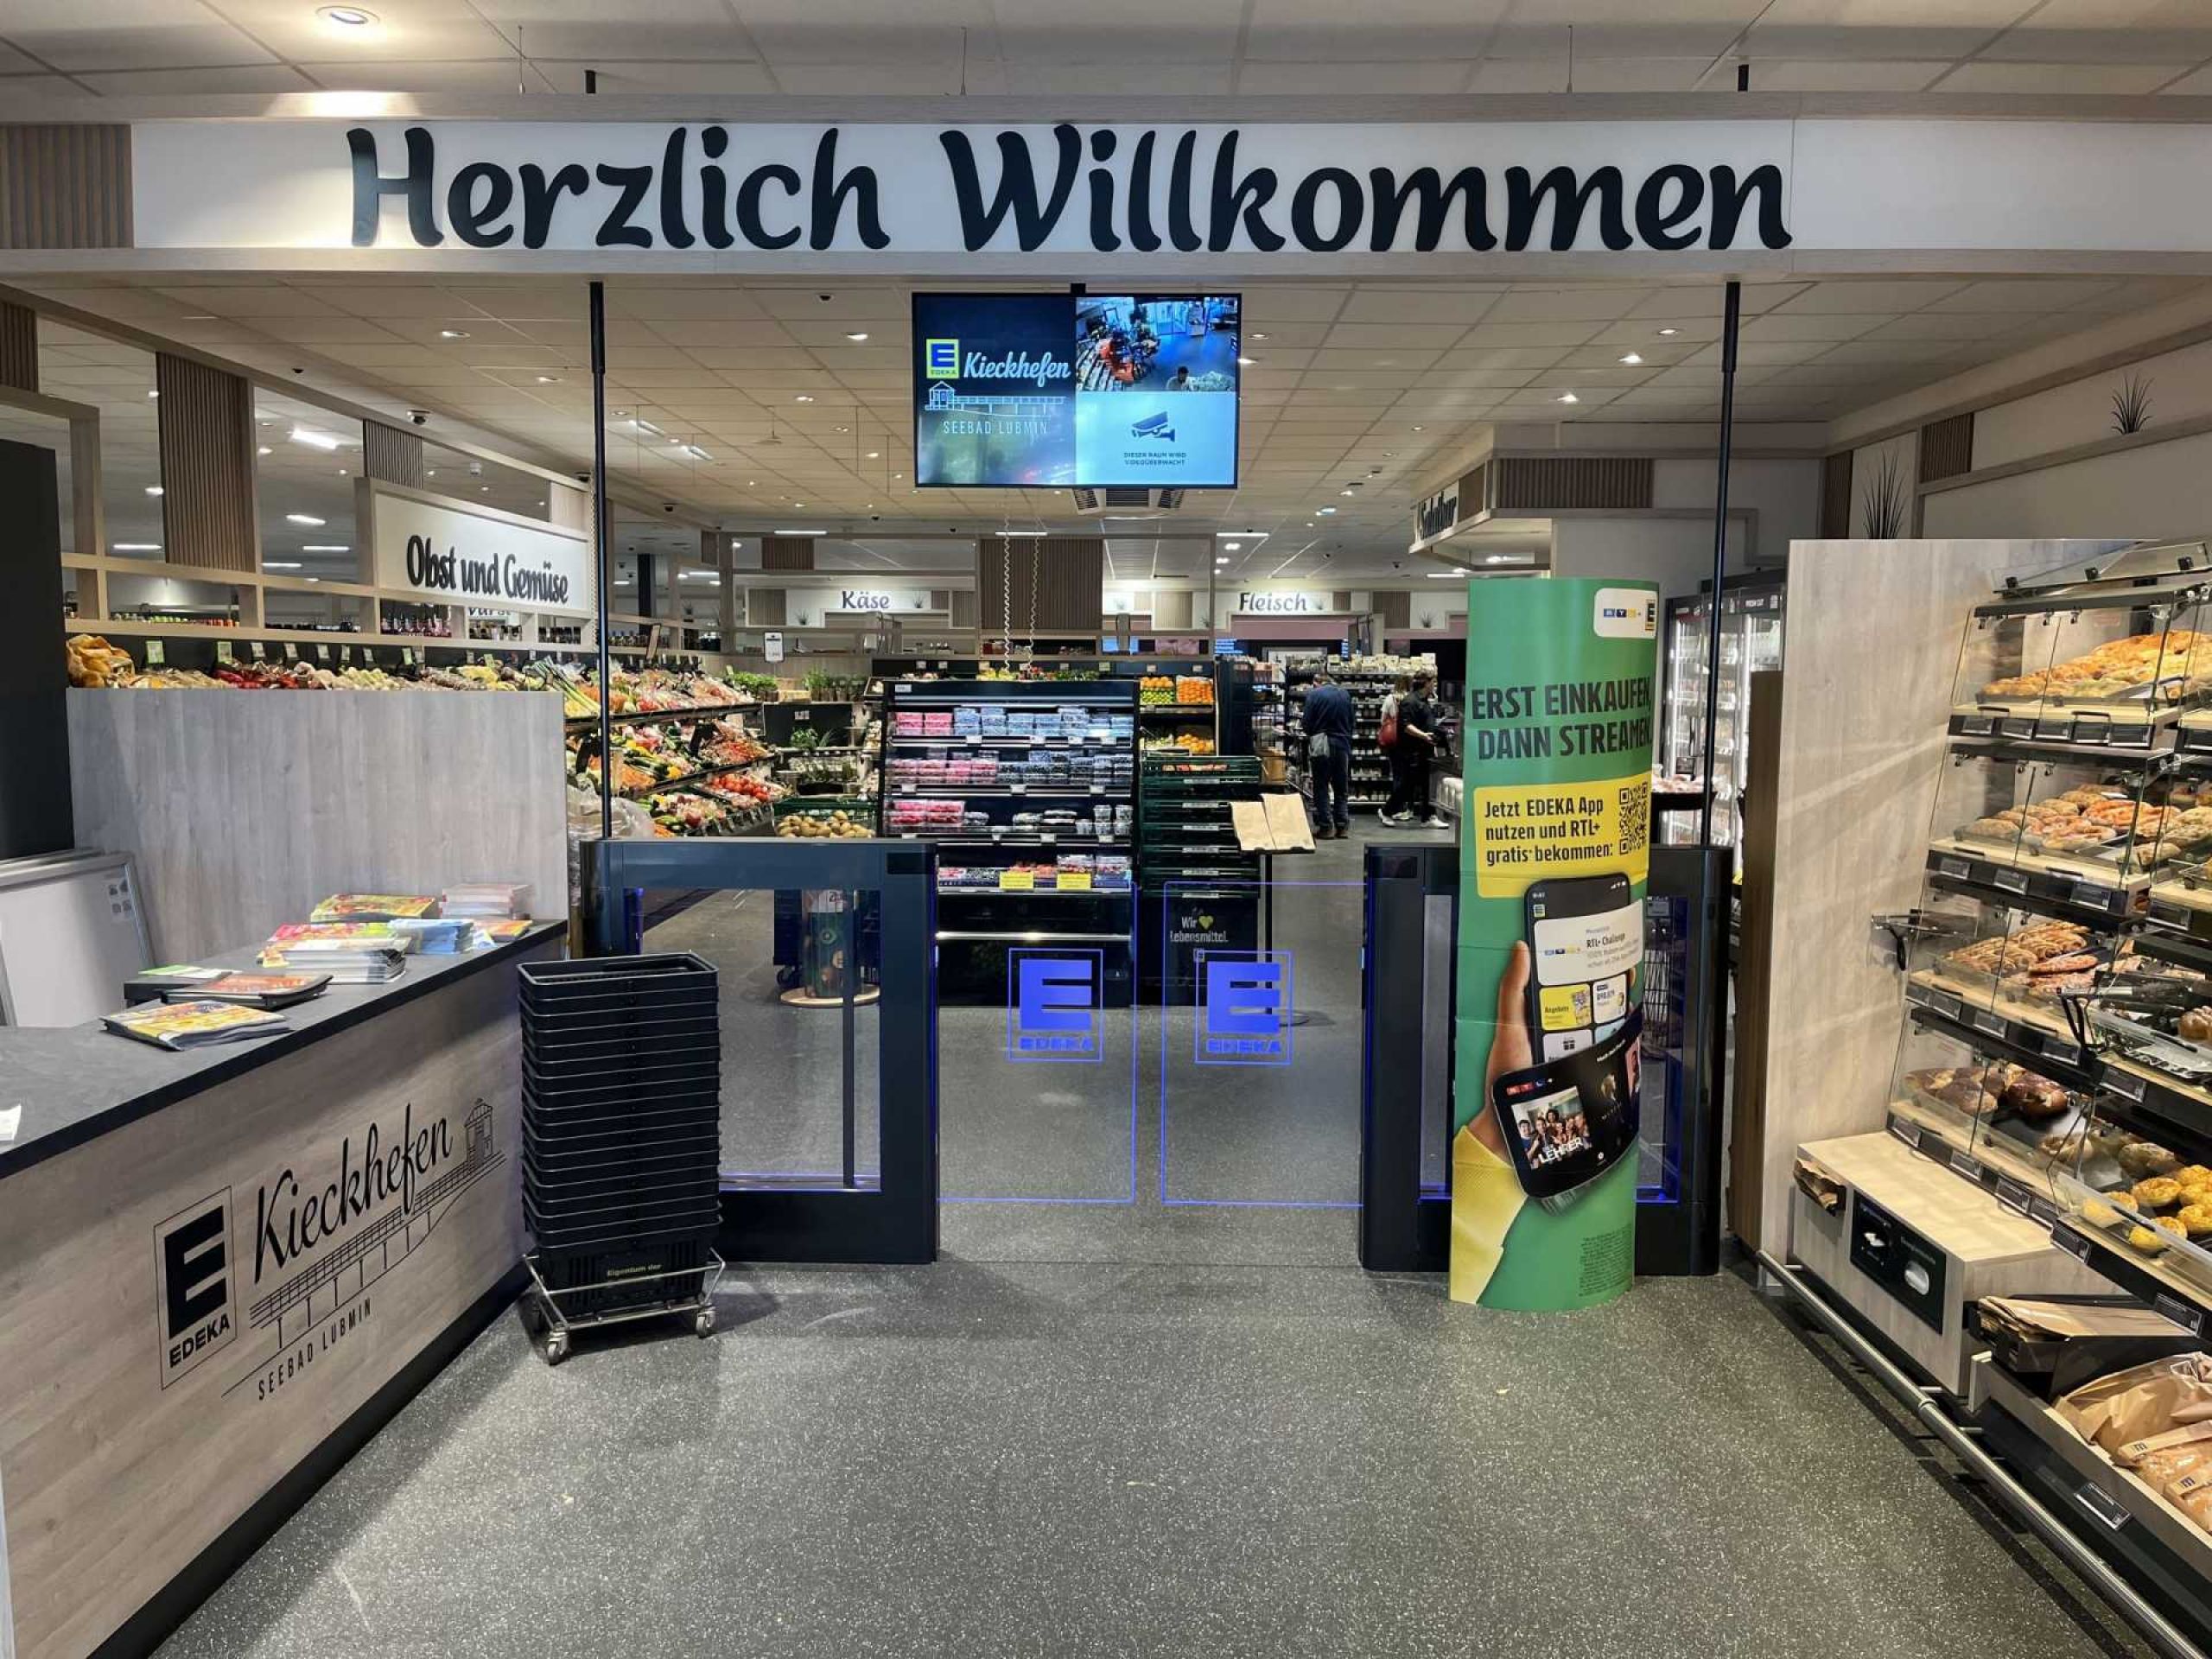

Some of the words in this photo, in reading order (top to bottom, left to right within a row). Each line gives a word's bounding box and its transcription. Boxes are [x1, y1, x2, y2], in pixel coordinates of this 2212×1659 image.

[347, 126, 891, 251] Herzlich
[939, 124, 1794, 253] Willkommen
[963, 351, 1071, 388] Kieckhefen
[943, 421, 992, 434] SEEBAD
[999, 421, 1048, 434] LUBMIN
[407, 535, 456, 590] Obst
[461, 553, 500, 595] und
[504, 553, 569, 604] Gemüse
[842, 590, 889, 609] Käse
[1239, 591, 1306, 611] Fleisch
[1471, 686, 1536, 719] ERST
[1478, 727, 1551, 760] DANN
[1484, 801, 1520, 817] Jetzt
[1527, 798, 1574, 817] EDEKA
[1579, 797, 1604, 817] App
[1485, 824, 1535, 840] nutzen
[1540, 820, 1567, 839] und
[1571, 819, 1600, 837] RTL+
[1181, 916, 1198, 929] Wir
[254, 1103, 454, 1285] Kieckhefen
[164, 1205, 227, 1340] E
[169, 1313, 231, 1369] EDEKA
[258, 1342, 314, 1402] SEEBAD
[322, 1297, 372, 1351] LUBMIN
